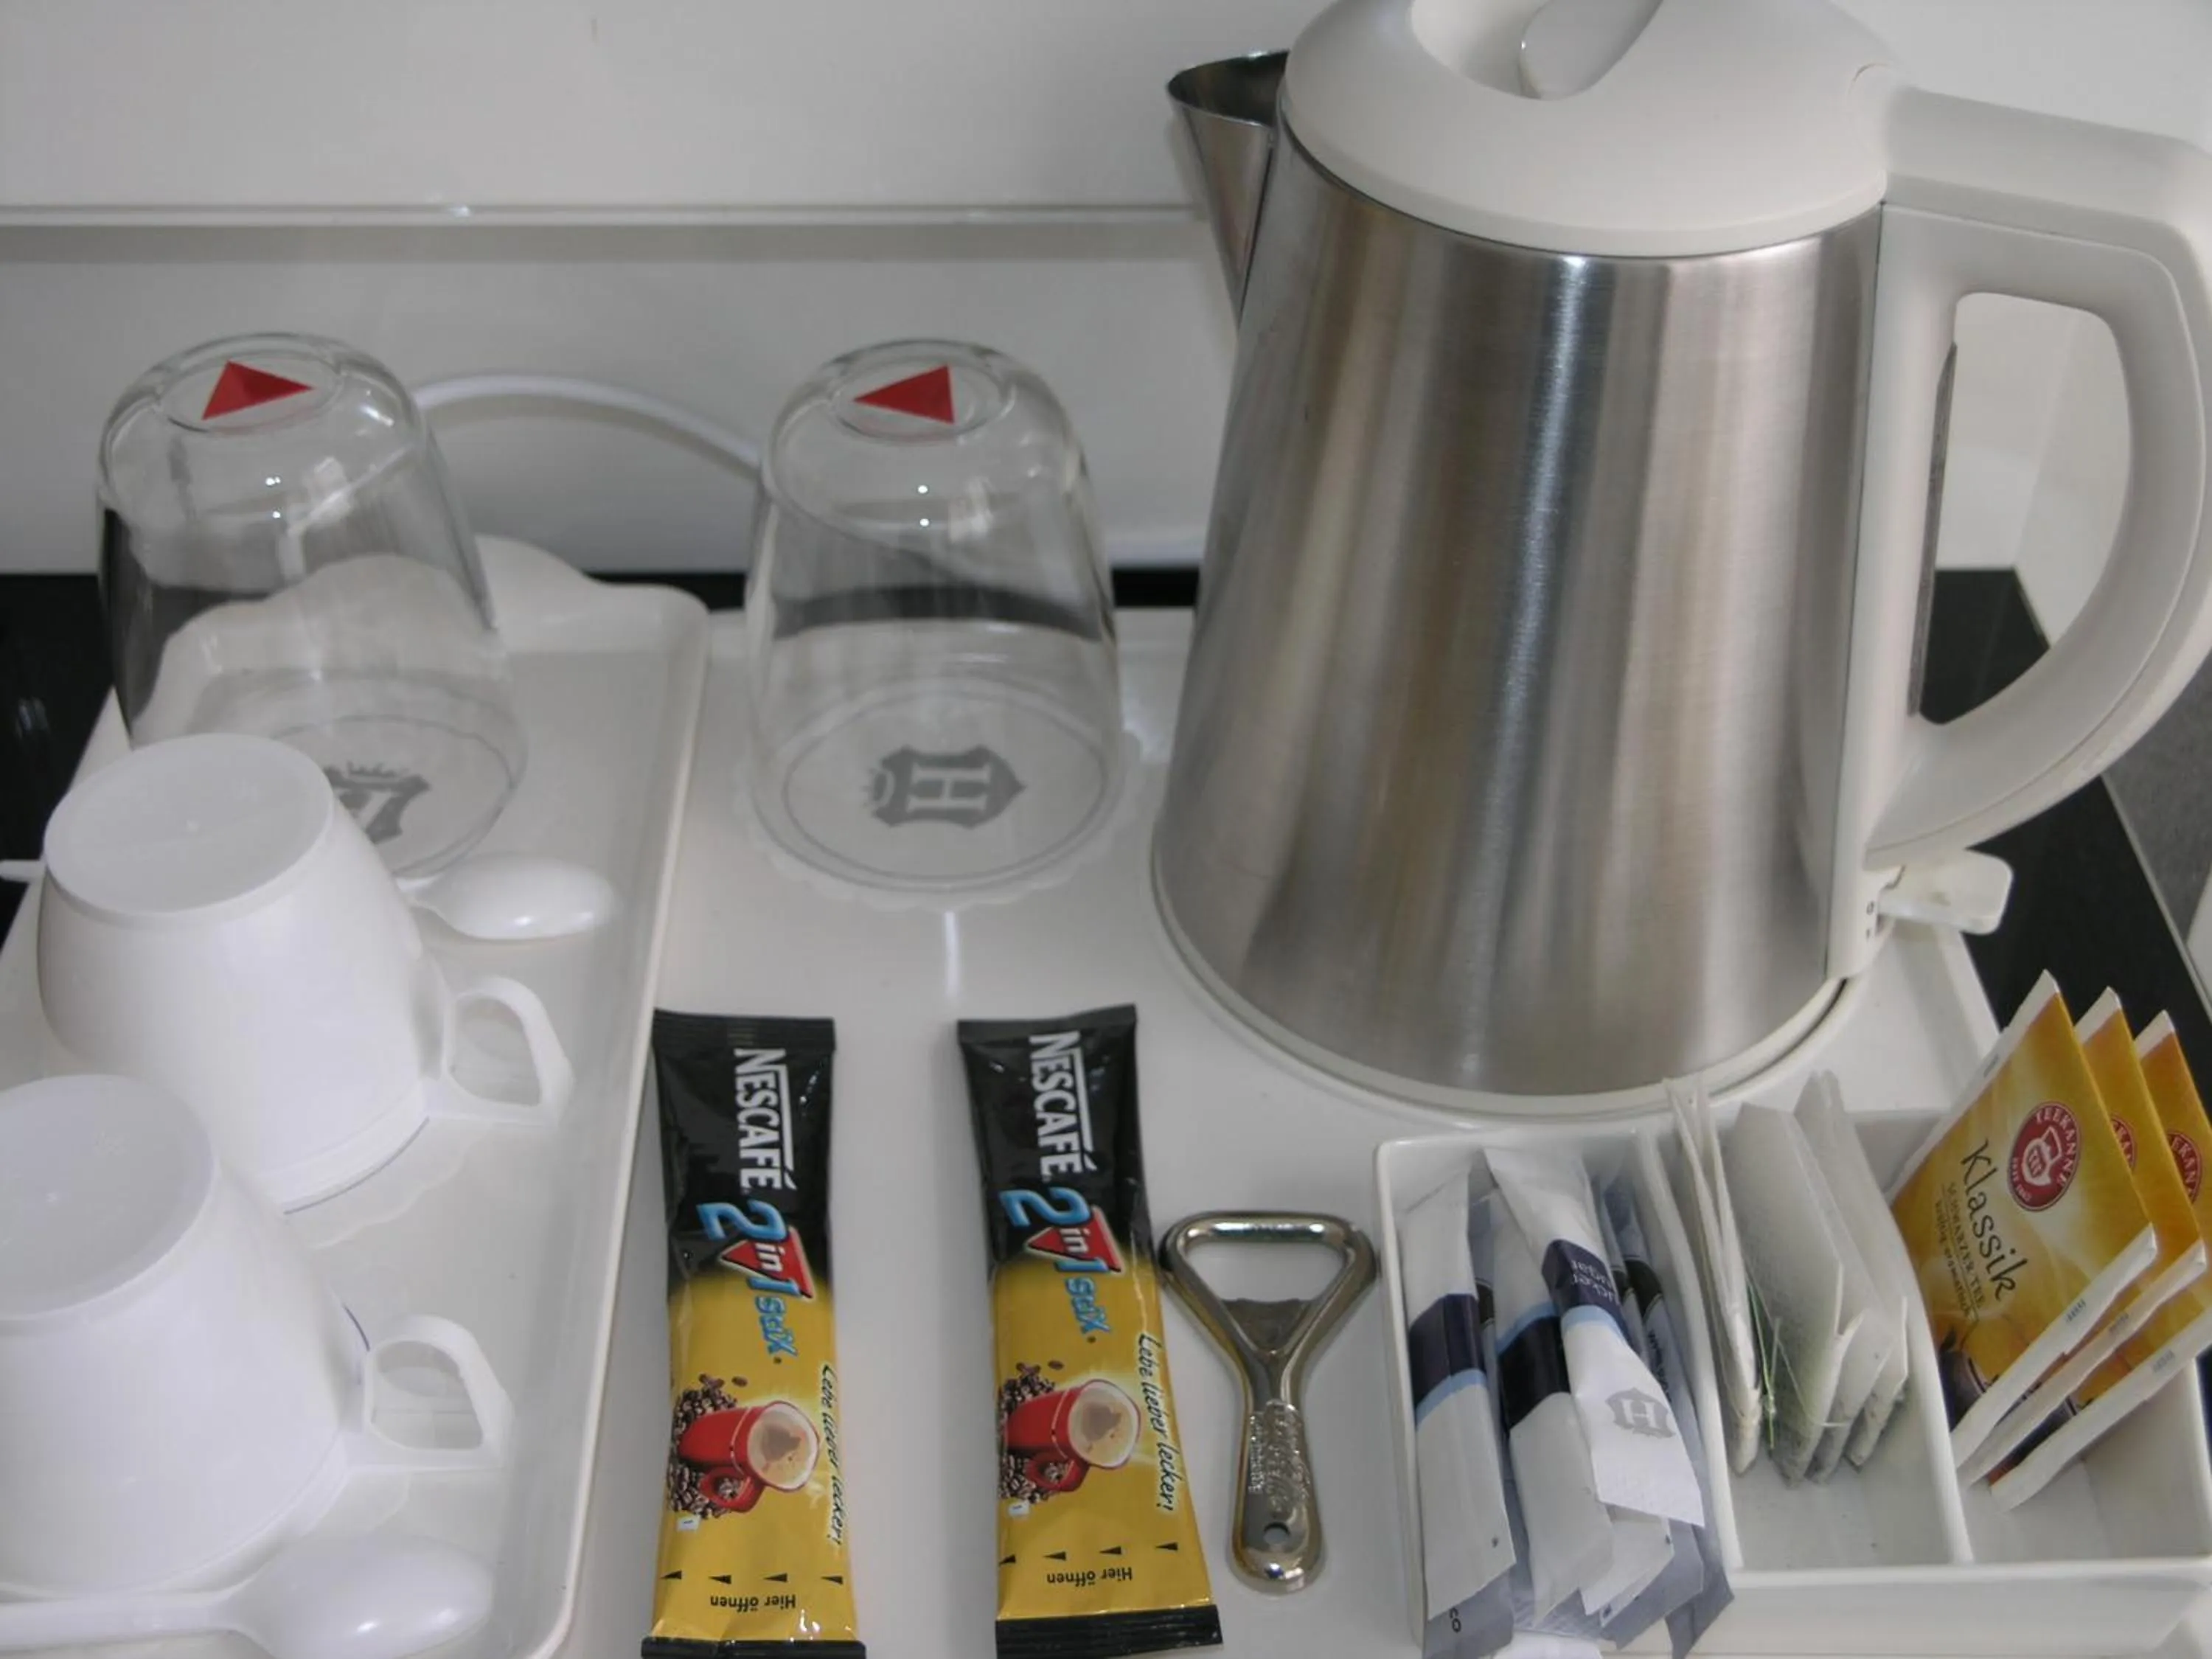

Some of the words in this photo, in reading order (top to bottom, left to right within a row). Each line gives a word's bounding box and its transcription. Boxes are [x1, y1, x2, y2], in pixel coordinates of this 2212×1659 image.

[733, 1048, 797, 1190] NESCAFÉ
[1029, 1030, 1098, 1176] NESCAFÉ
[2036, 1107, 2076, 1187] TEEKANNE
[1961, 1137, 2028, 1301] Klassik
[1157, 1441, 1184, 1512] lecker!
[710, 1596, 758, 1613] öffnen
[764, 1594, 796, 1610] Hier
[1046, 1571, 1096, 1587] öffnen
[1101, 1567, 1133, 1582] Hier
